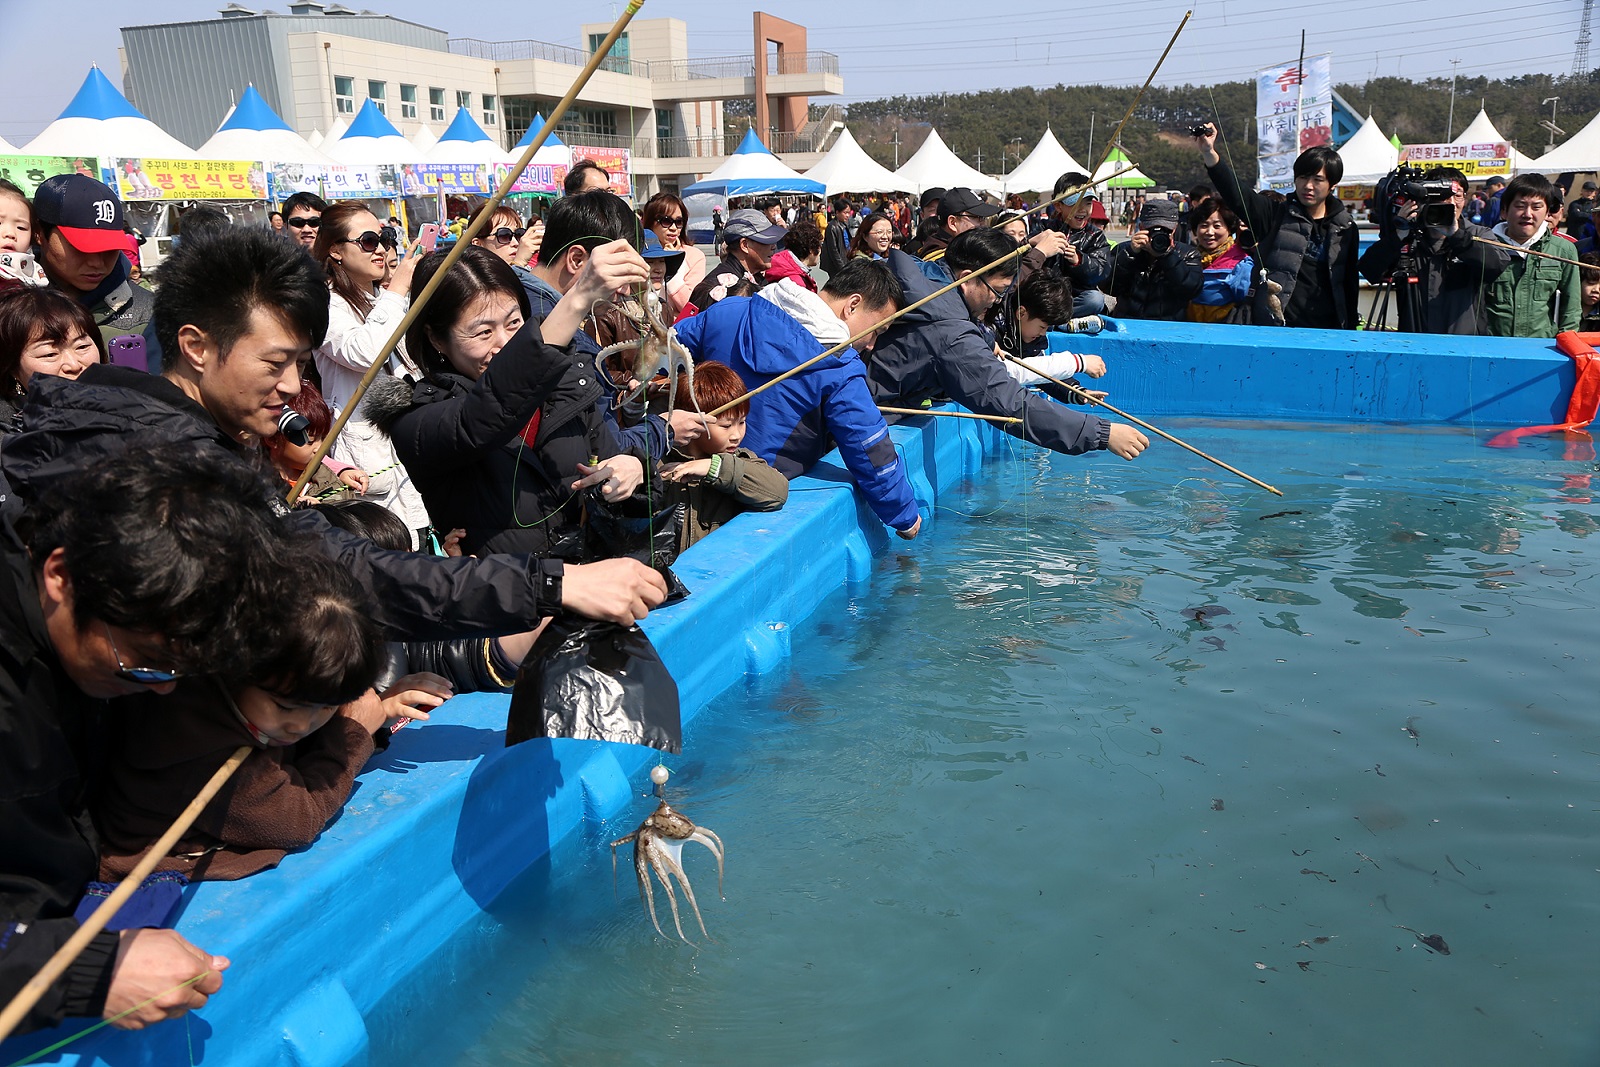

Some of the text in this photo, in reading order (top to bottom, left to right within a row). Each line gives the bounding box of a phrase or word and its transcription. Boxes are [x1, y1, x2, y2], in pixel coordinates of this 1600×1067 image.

[1424, 147, 1441, 158] 황토
[1442, 145, 1468, 158] 고구마
[146, 160, 170, 170] 주꾸미
[155, 173, 246, 190] 광천식당
[305, 169, 371, 190] 어부의 집
[423, 172, 476, 188] 대박집
